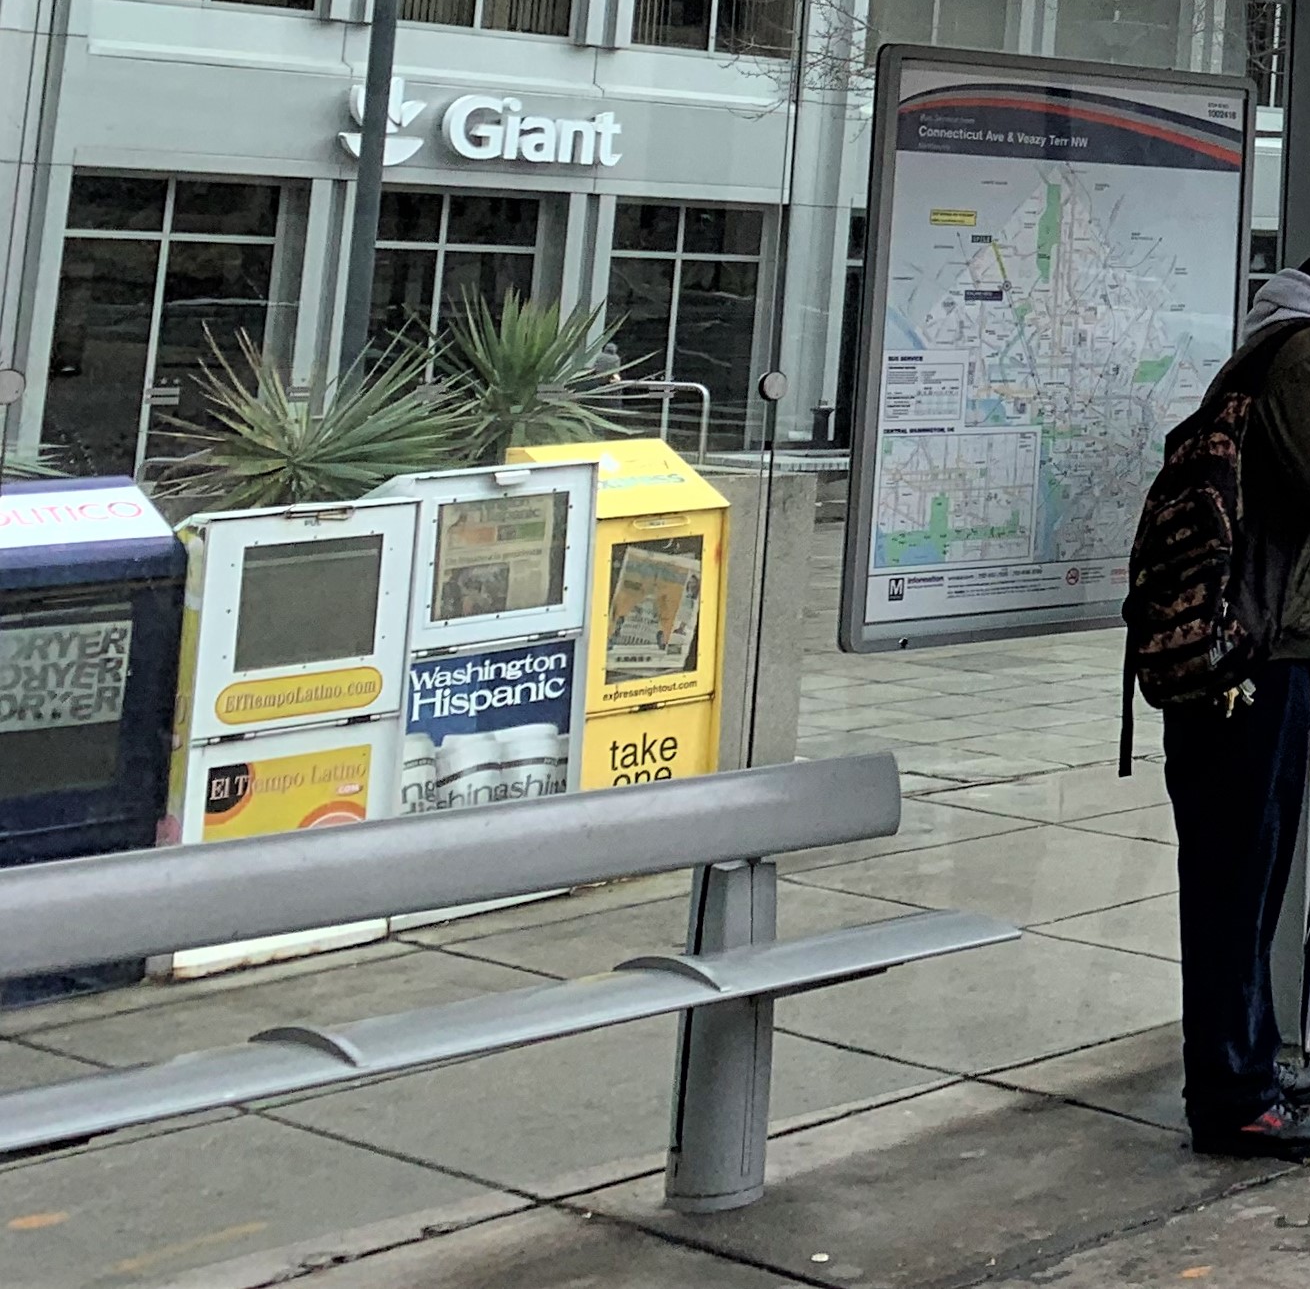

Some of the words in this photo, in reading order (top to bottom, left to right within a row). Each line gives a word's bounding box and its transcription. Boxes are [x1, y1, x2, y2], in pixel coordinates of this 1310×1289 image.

[442, 94, 622, 166] Giant
[919, 126, 984, 141] Connecticut
[986, 131, 1005, 142] Ave
[1007, 132, 1014, 142] &
[1017, 132, 1047, 147] Veazy
[1050, 135, 1069, 146] Terr
[1071, 136, 1089, 147] NW
[411, 652, 566, 691] Washington
[603, 680, 697, 702] expressnightout.com
[411, 673, 566, 722] Hispanic
[610, 732, 678, 771] take
[210, 779, 229, 800] El
[309, 760, 367, 784] Latino
